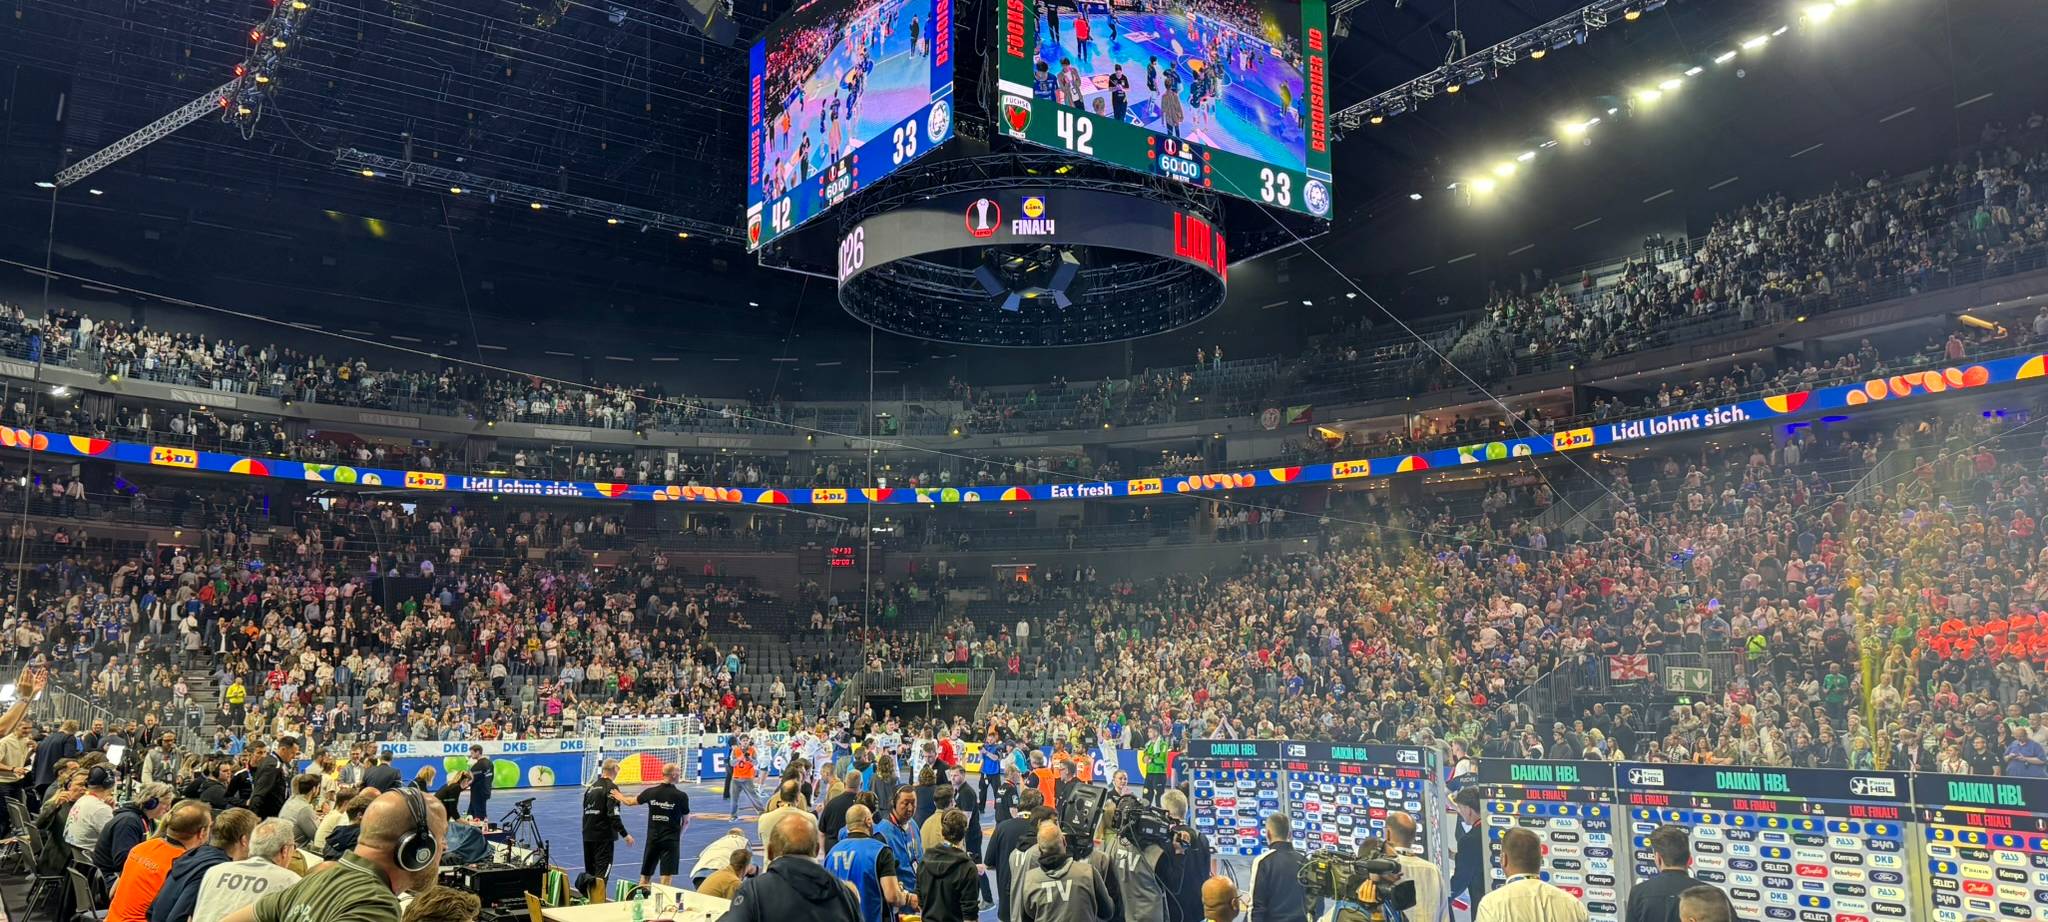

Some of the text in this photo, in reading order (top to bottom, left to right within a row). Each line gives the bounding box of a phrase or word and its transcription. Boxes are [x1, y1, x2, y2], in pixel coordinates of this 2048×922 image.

[1057, 110, 1093, 155] 42
[892, 119, 917, 165] 33
[1161, 155, 1197, 177] 60:00
[1260, 168, 1291, 206] 33
[772, 196, 791, 233] 42
[1012, 219, 1055, 235] FINAL4
[1611, 405, 1750, 441] Lidl lohnt sich.
[1556, 432, 1591, 448] LIDL
[153, 449, 194, 464] LIDL
[1335, 463, 1367, 475] LIDL
[407, 473, 443, 486] LIDL
[462, 477, 583, 496] Lidl lohnt sich.
[1051, 482, 1112, 498] Eat fresh
[1130, 481, 1160, 493] LIDL
[815, 490, 844, 501] LIDL
[381, 743, 407, 753] DKB
[443, 743, 468, 753] DKB
[503, 742, 527, 752] DKB
[560, 740, 583, 750] DKB
[614, 738, 637, 747] DKB
[1211, 743, 1258, 755] DAIKIN HBL
[1181, 762, 1189, 775] 2
[1511, 764, 1580, 782] DAIKIN HBL
[1716, 771, 1790, 792] DAIKIN HBL
[1526, 789, 1567, 800] LIDL FINAL4
[1870, 785, 1893, 793] HBL
[1948, 781, 2026, 806] DAIKIN HBL
[1630, 794, 1643, 804] LIDL
[1733, 799, 1777, 811] LIDL FINAL4
[1849, 805, 1898, 818] LIDL FINAL4
[1966, 813, 2012, 828] LIDL FINAL4
[1698, 842, 1720, 851] Kempa
[1733, 844, 1750, 852] DKB
[832, 850, 856, 870] TV
[1117, 848, 1141, 872] TV
[1834, 853, 1859, 862] Kempa
[1874, 855, 1894, 863] DKB
[1764, 863, 1789, 872] SELECT
[1589, 876, 1611, 884] Kempa
[1999, 869, 2024, 880] Kempa
[216, 872, 268, 893] FOTO
[1933, 878, 1956, 889] SELECT
[1041, 879, 1073, 903] TV
[1733, 889, 1757, 898] Kempa
[1875, 904, 1902, 914] Kempa
[1939, 910, 1956, 919] DKB
[1803, 912, 1828, 921] SELECT
